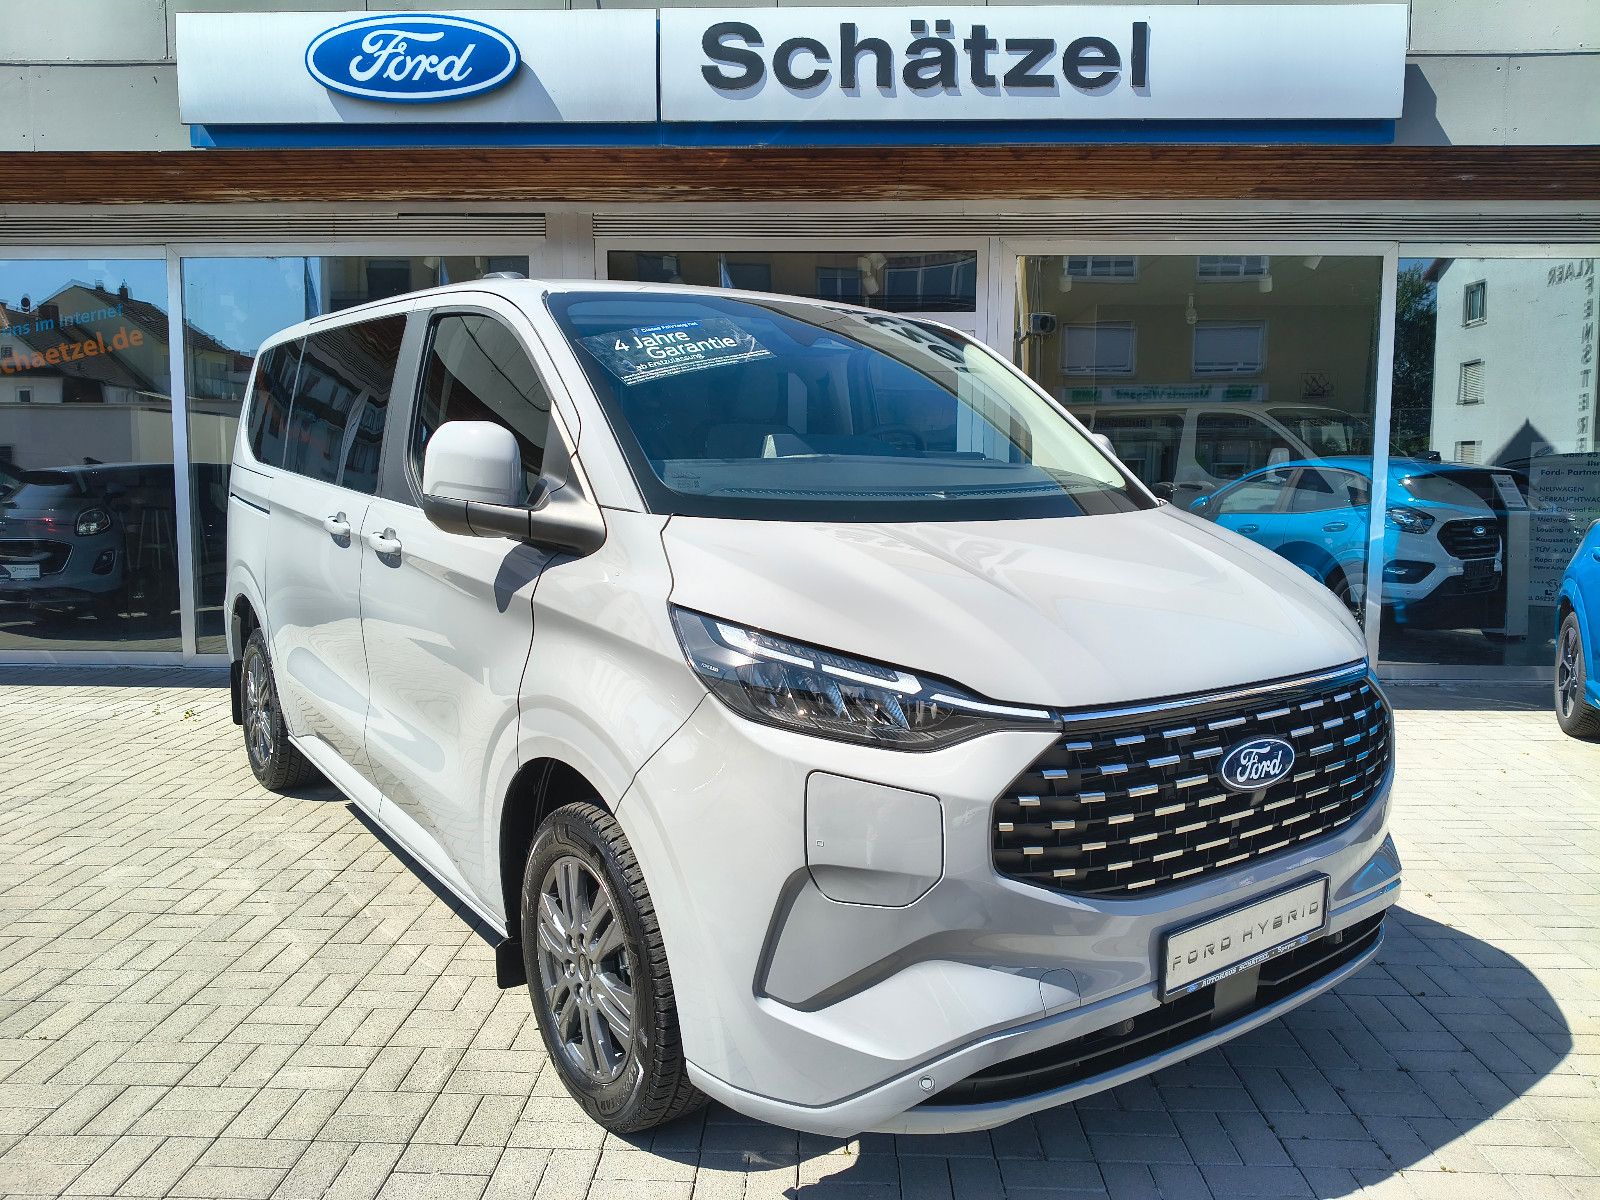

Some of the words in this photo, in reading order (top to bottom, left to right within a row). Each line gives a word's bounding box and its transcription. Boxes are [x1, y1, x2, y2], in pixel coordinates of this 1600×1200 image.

[348, 29, 477, 82] Ford
[700, 19, 1148, 90] Schätzel
[35, 318, 55, 333] im
[59, 303, 124, 328] Internet
[0, 326, 144, 376] chaetzel.de
[614, 338, 629, 352] 4
[633, 331, 690, 349] Jahre
[646, 335, 738, 360] Garantie
[1236, 745, 1283, 783] Ford
[1171, 935, 1232, 971] FORD
[1242, 900, 1319, 943] HYBRID
